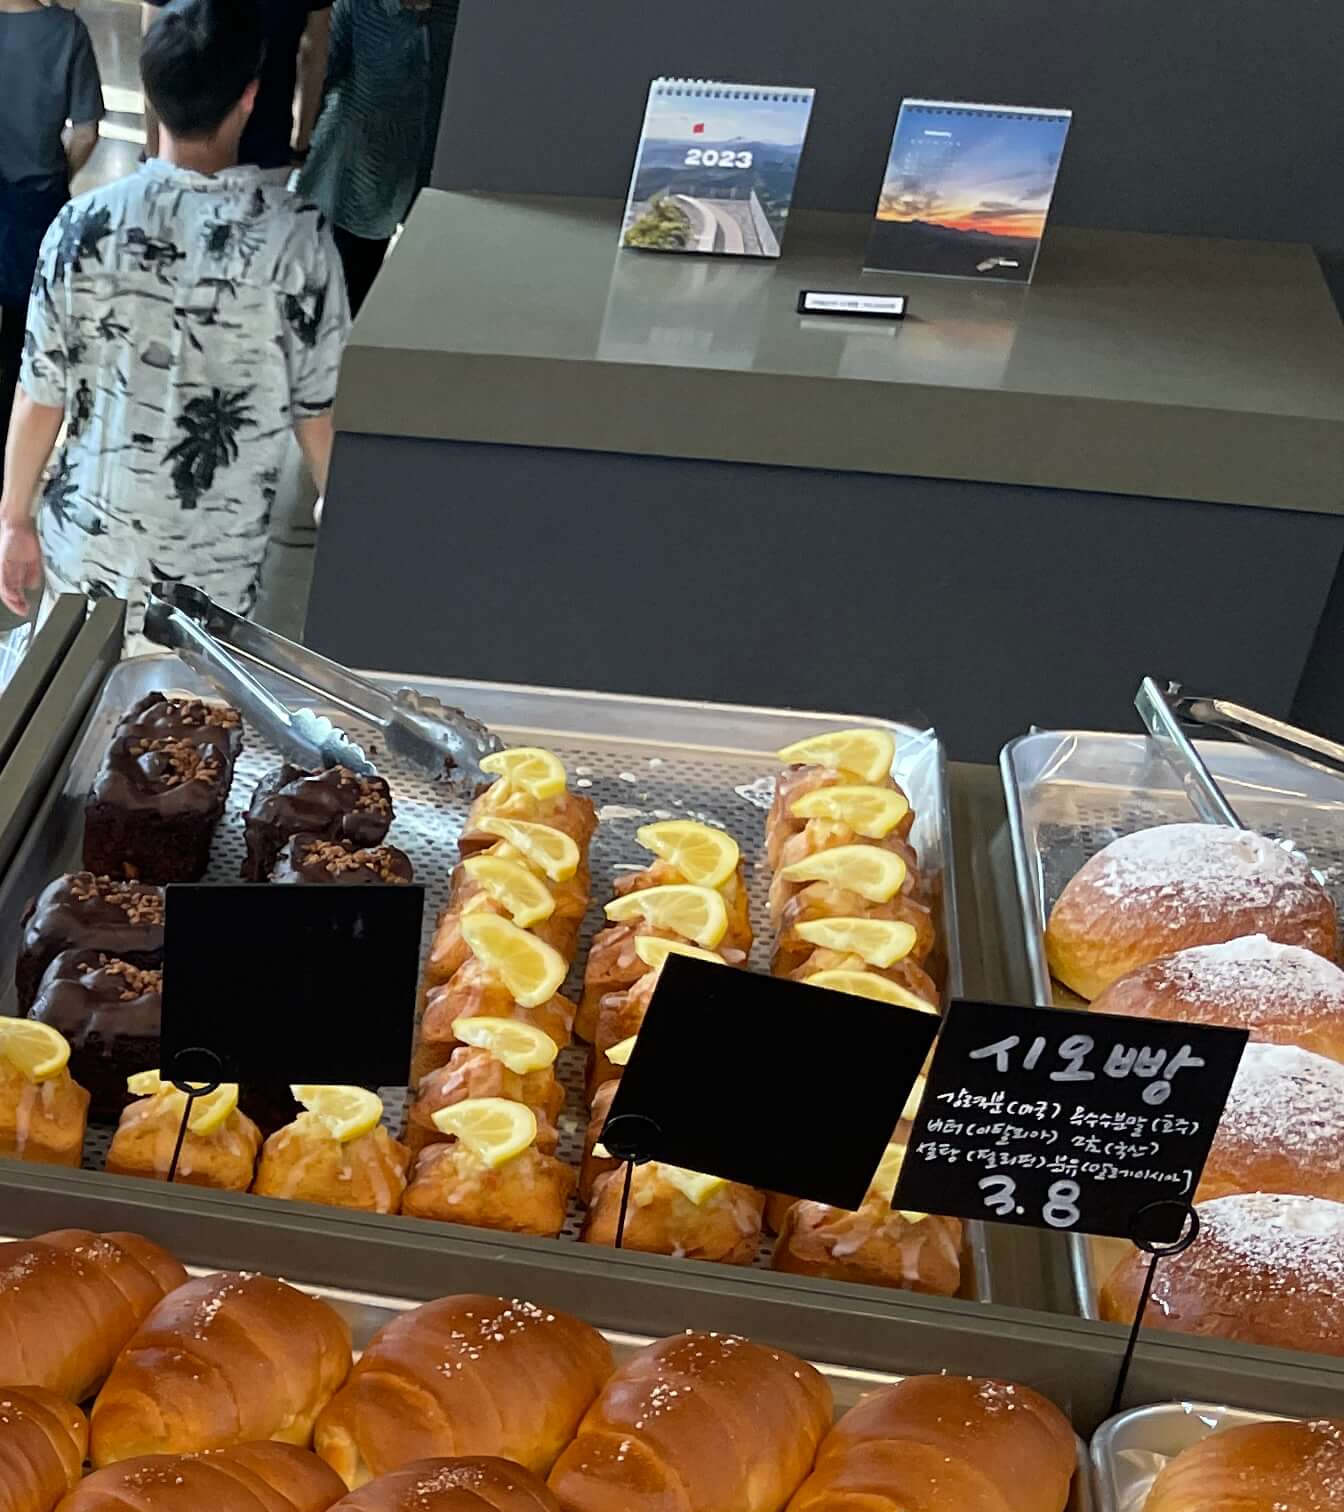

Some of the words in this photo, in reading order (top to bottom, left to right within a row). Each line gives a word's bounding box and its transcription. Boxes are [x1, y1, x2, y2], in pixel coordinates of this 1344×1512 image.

[684, 148, 753, 169] 2023
[969, 1034, 1205, 1105] 시오빵
[977, 1174, 1081, 1227] 3.8
